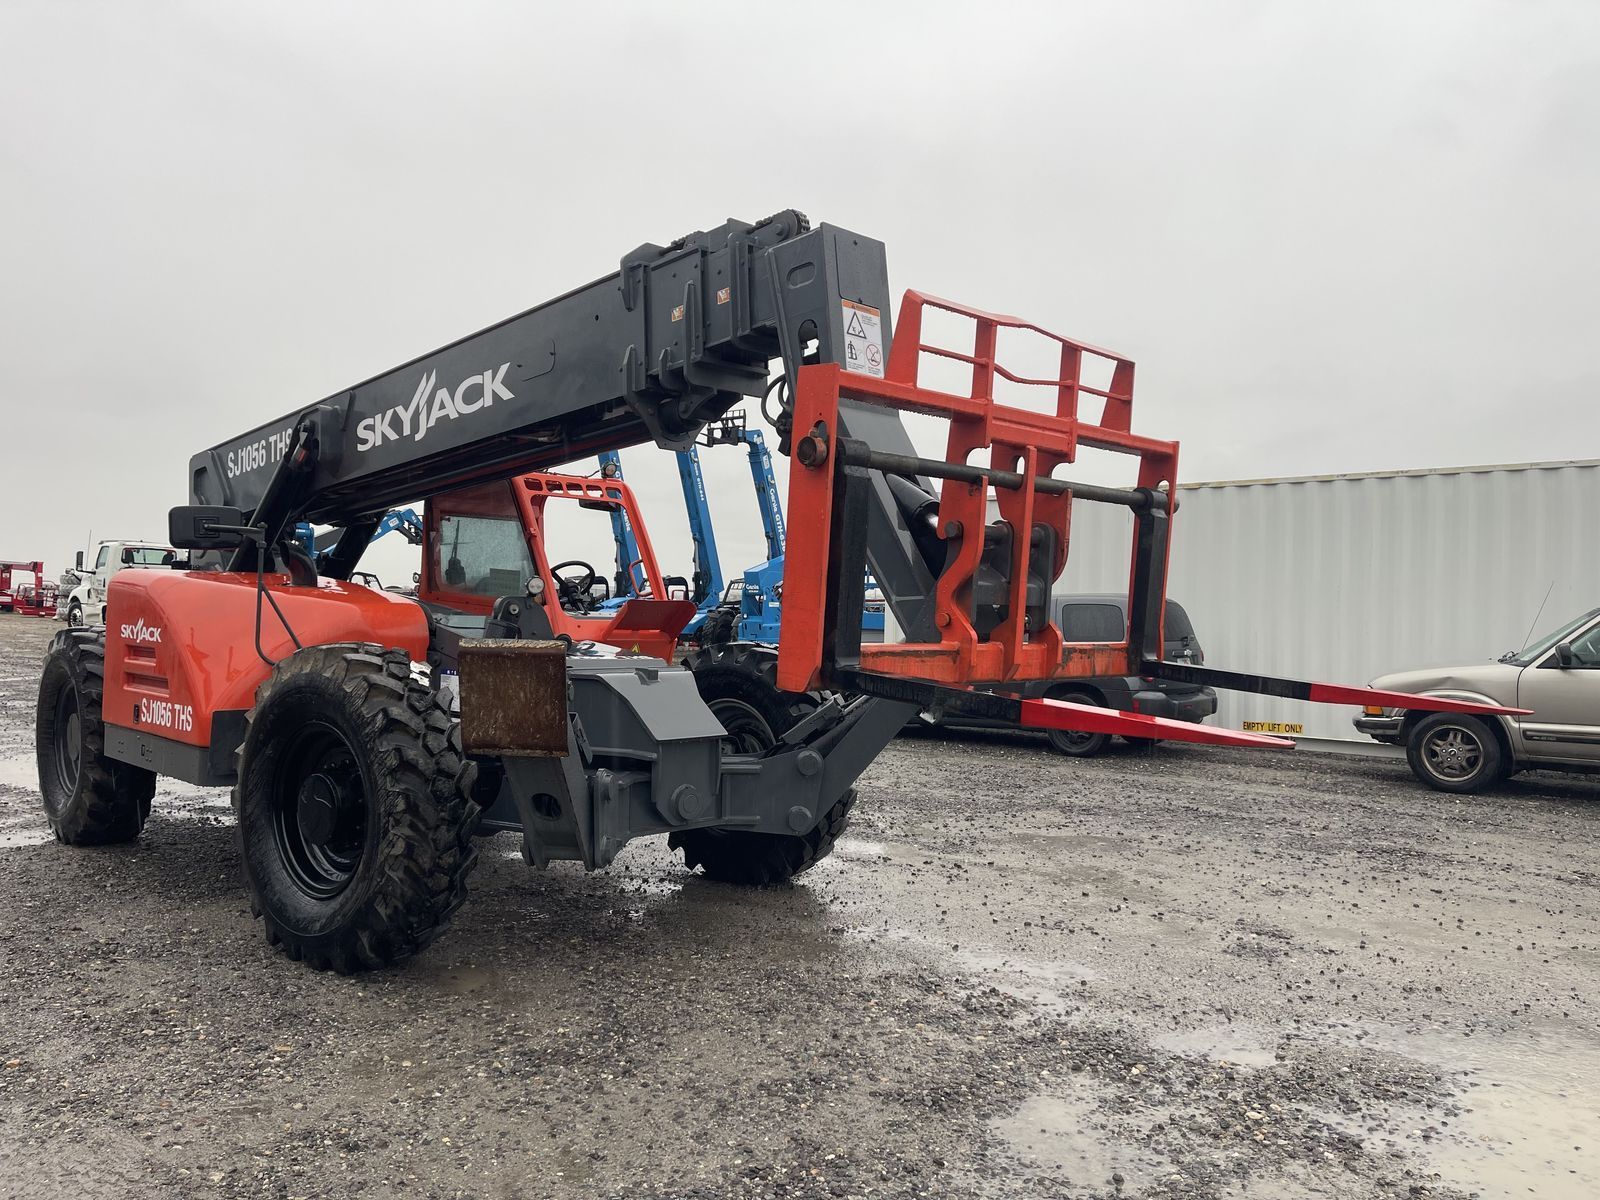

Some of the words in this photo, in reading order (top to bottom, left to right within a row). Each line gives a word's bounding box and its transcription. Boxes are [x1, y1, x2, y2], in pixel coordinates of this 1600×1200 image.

[356, 362, 516, 451] SKYJACK
[227, 439, 267, 479] SJ1056
[769, 488, 778, 513] Genie
[120, 617, 162, 643] SKYJACK
[141, 697, 172, 728] SJ1056
[174, 703, 193, 732] THS
[1243, 721, 1265, 731] EMPTY
[1268, 723, 1280, 733] LIFT
[1284, 723, 1303, 734] ONLY
